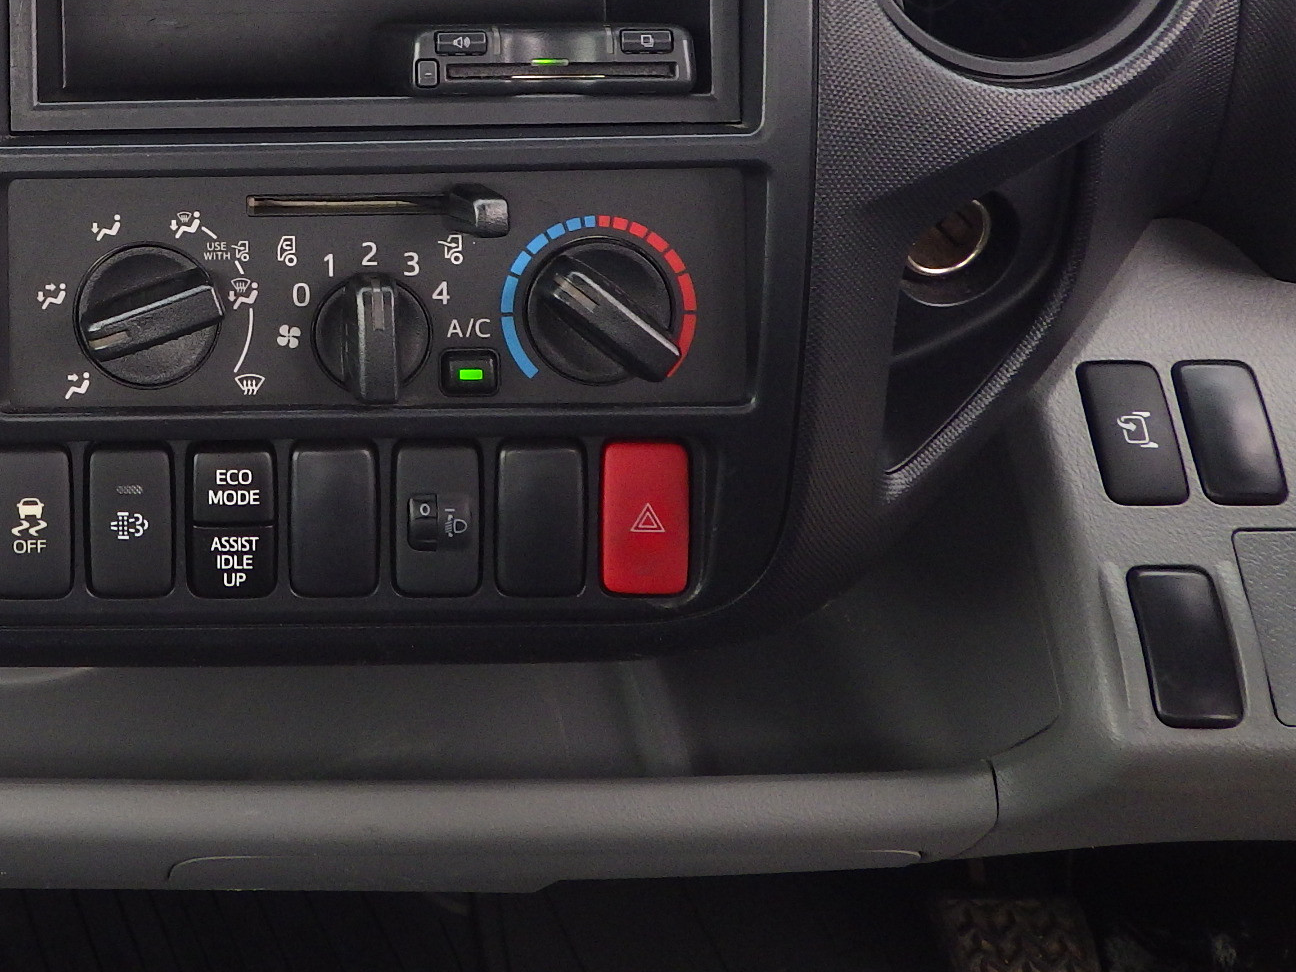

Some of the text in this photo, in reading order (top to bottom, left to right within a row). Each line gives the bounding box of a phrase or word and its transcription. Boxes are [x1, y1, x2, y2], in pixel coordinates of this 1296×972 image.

[207, 241, 227, 252] USE
[361, 241, 378, 266] 2
[203, 251, 231, 261] WITH
[403, 251, 420, 276] 3
[323, 253, 334, 277] 1
[292, 282, 310, 307] 0
[431, 281, 451, 305] 4
[447, 318, 491, 338] A/C
[215, 469, 253, 486] ECO
[207, 490, 261, 506] MODE
[12, 539, 47, 554] OFF
[210, 536, 260, 552] ASSIST
[216, 554, 253, 570] IDLE
[222, 572, 247, 587] UP
